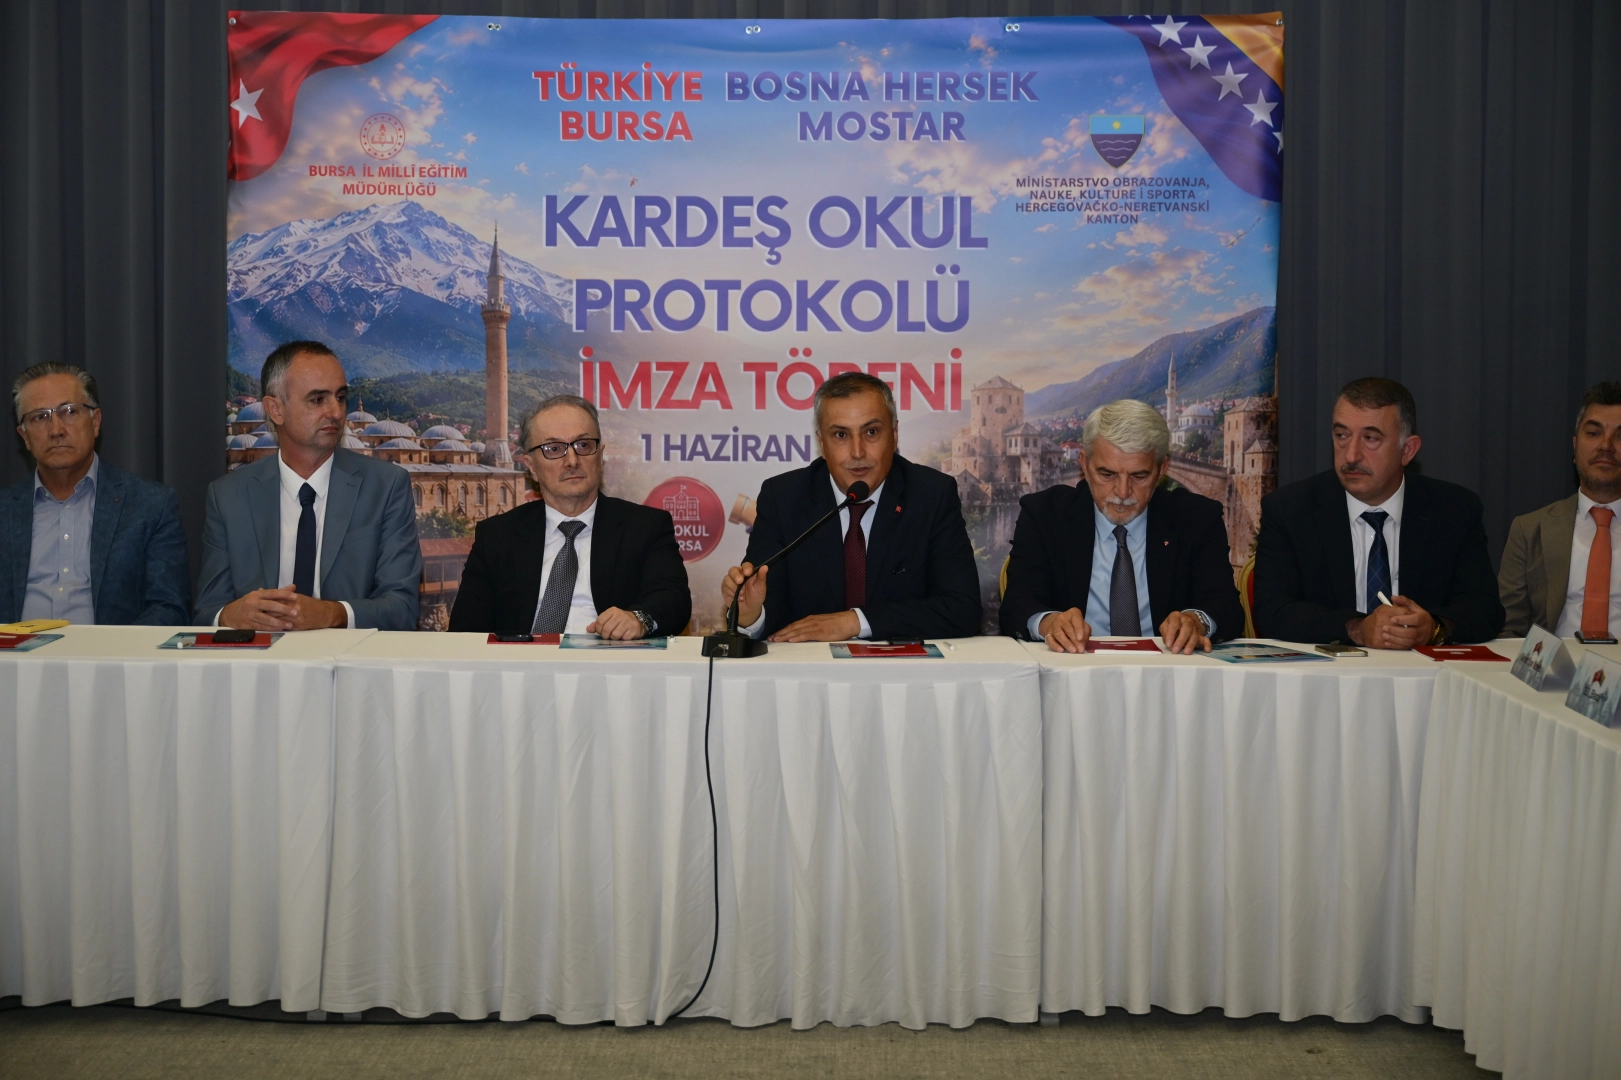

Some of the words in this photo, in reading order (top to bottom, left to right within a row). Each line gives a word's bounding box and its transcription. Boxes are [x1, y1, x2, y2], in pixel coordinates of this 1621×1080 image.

[532, 61, 703, 101] TÜRKİYE
[725, 71, 870, 102] BOSNA
[883, 71, 1039, 102] HERSEK
[560, 110, 694, 142] BURSA
[798, 111, 966, 142] MOSTAR
[309, 165, 356, 177] BURSA
[362, 164, 375, 178] İL
[418, 164, 468, 178] EĞİTİM
[1016, 176, 1109, 188] MİNİSTARSTVO
[1112, 177, 1210, 189] OBRAZOVANJA,
[342, 181, 437, 196] MÜDÜRLÜĞÜ
[1029, 190, 1076, 201] NAUKE,
[1079, 190, 1136, 200] KULTURE
[1147, 190, 1196, 200] SPORTA
[543, 195, 791, 265] KARDEŞ
[808, 195, 989, 249] OKUL
[1086, 214, 1139, 224] KANTON
[573, 263, 970, 332] PROTOKOLÜ
[579, 346, 734, 410] İMZA
[742, 347, 962, 411] TÖENİ
[640, 434, 652, 461] 1
[662, 426, 811, 462] HAZİRAN
[674, 525, 710, 537] OKUL
